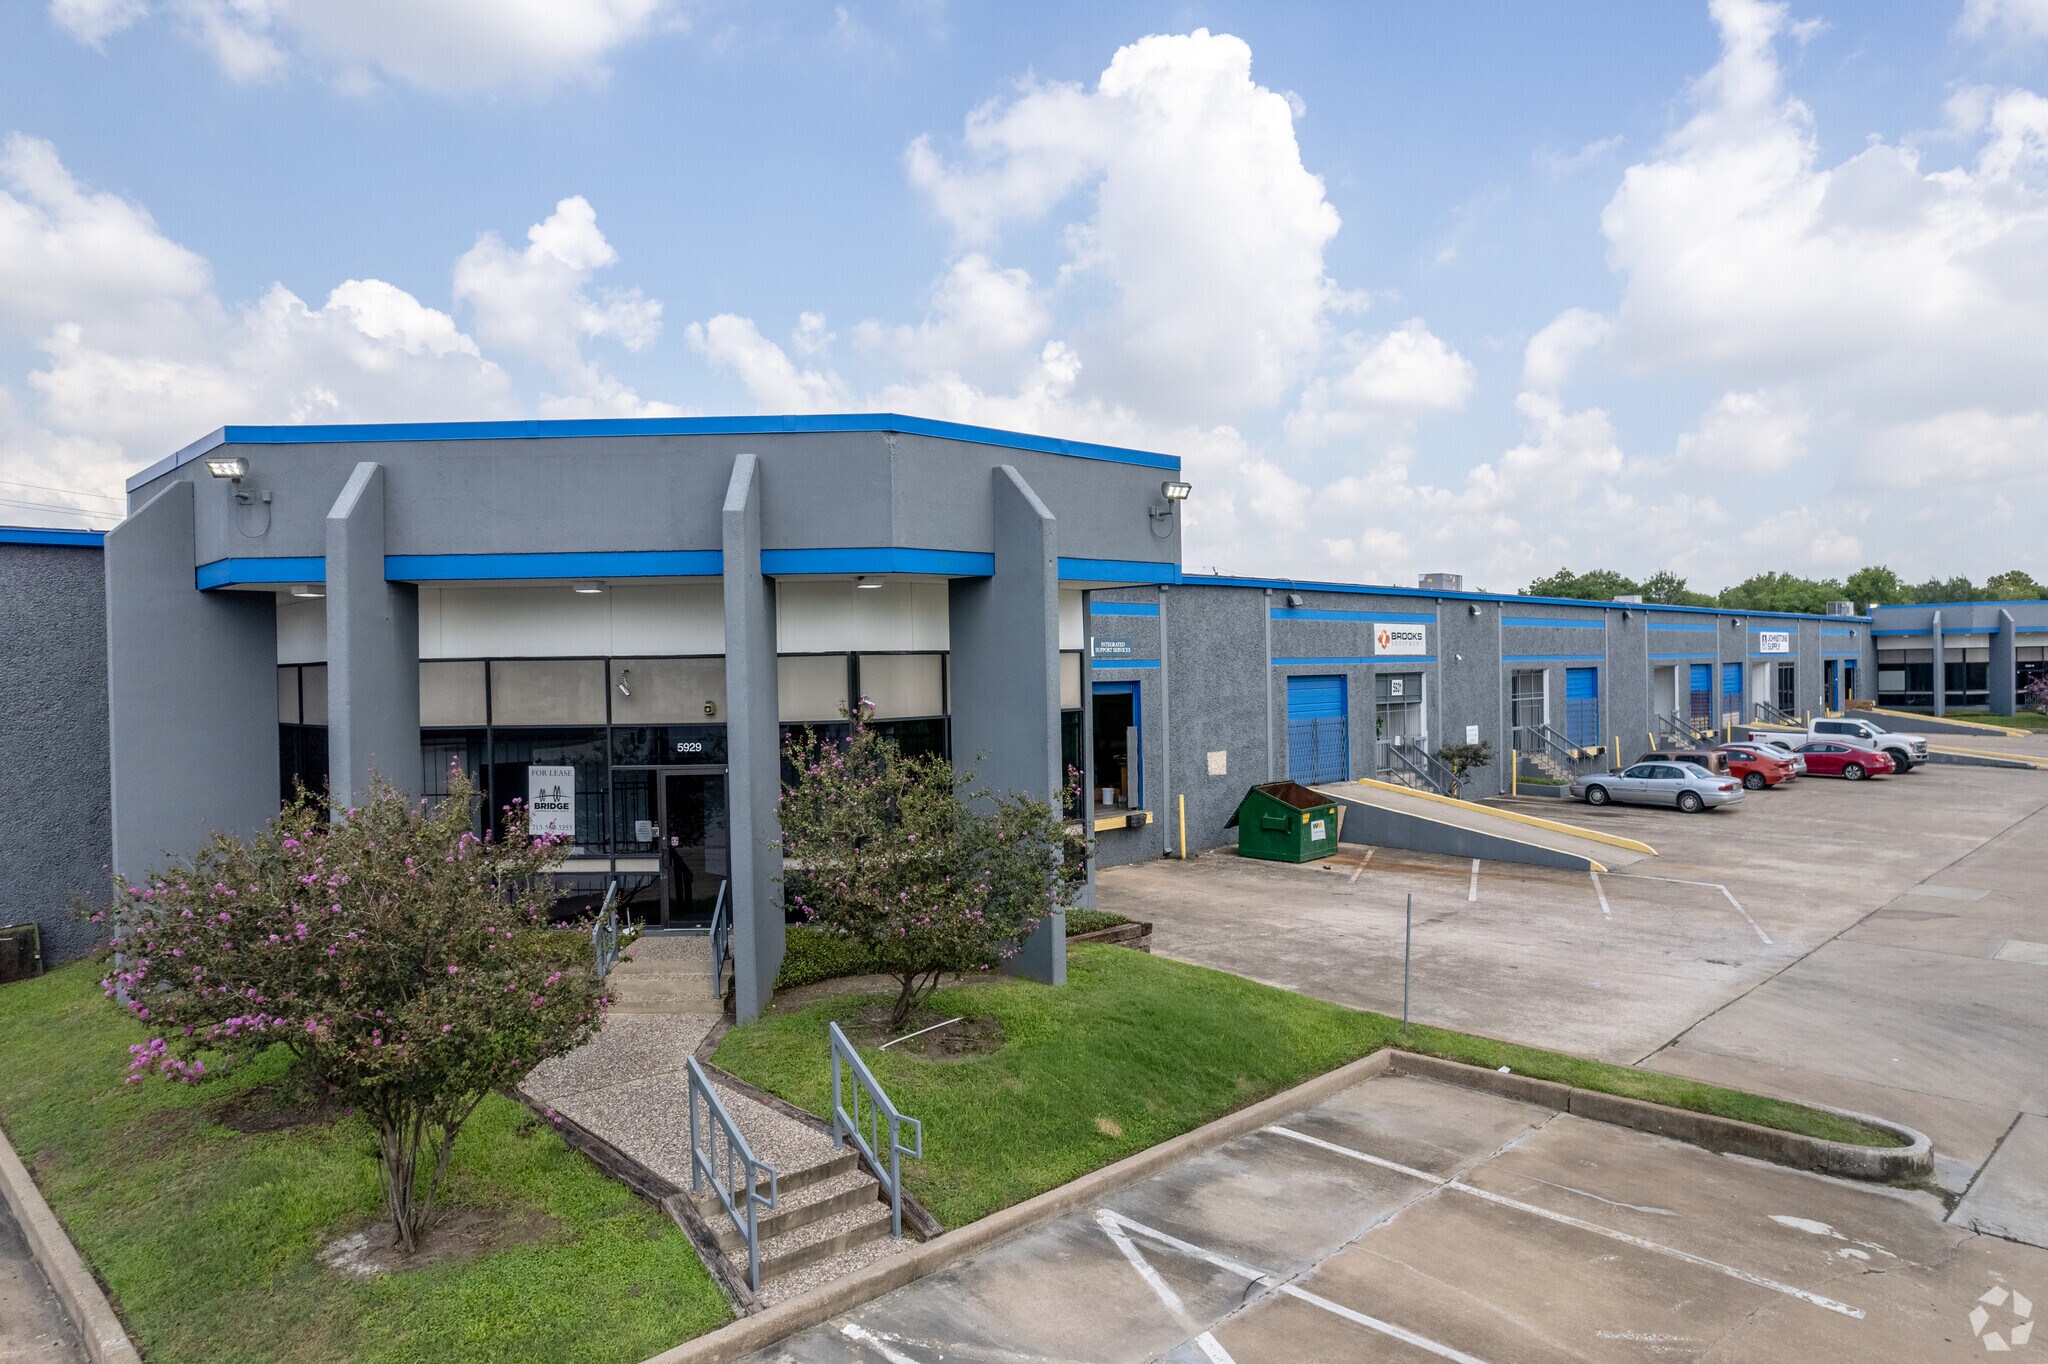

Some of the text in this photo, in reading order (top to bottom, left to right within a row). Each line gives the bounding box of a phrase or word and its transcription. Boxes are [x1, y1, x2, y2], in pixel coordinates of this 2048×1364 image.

[1391, 632, 1423, 641] BROOKS
[677, 742, 702, 752] 5929
[531, 769, 573, 777] FOR LEASE
[534, 802, 570, 810] BRIDGE
